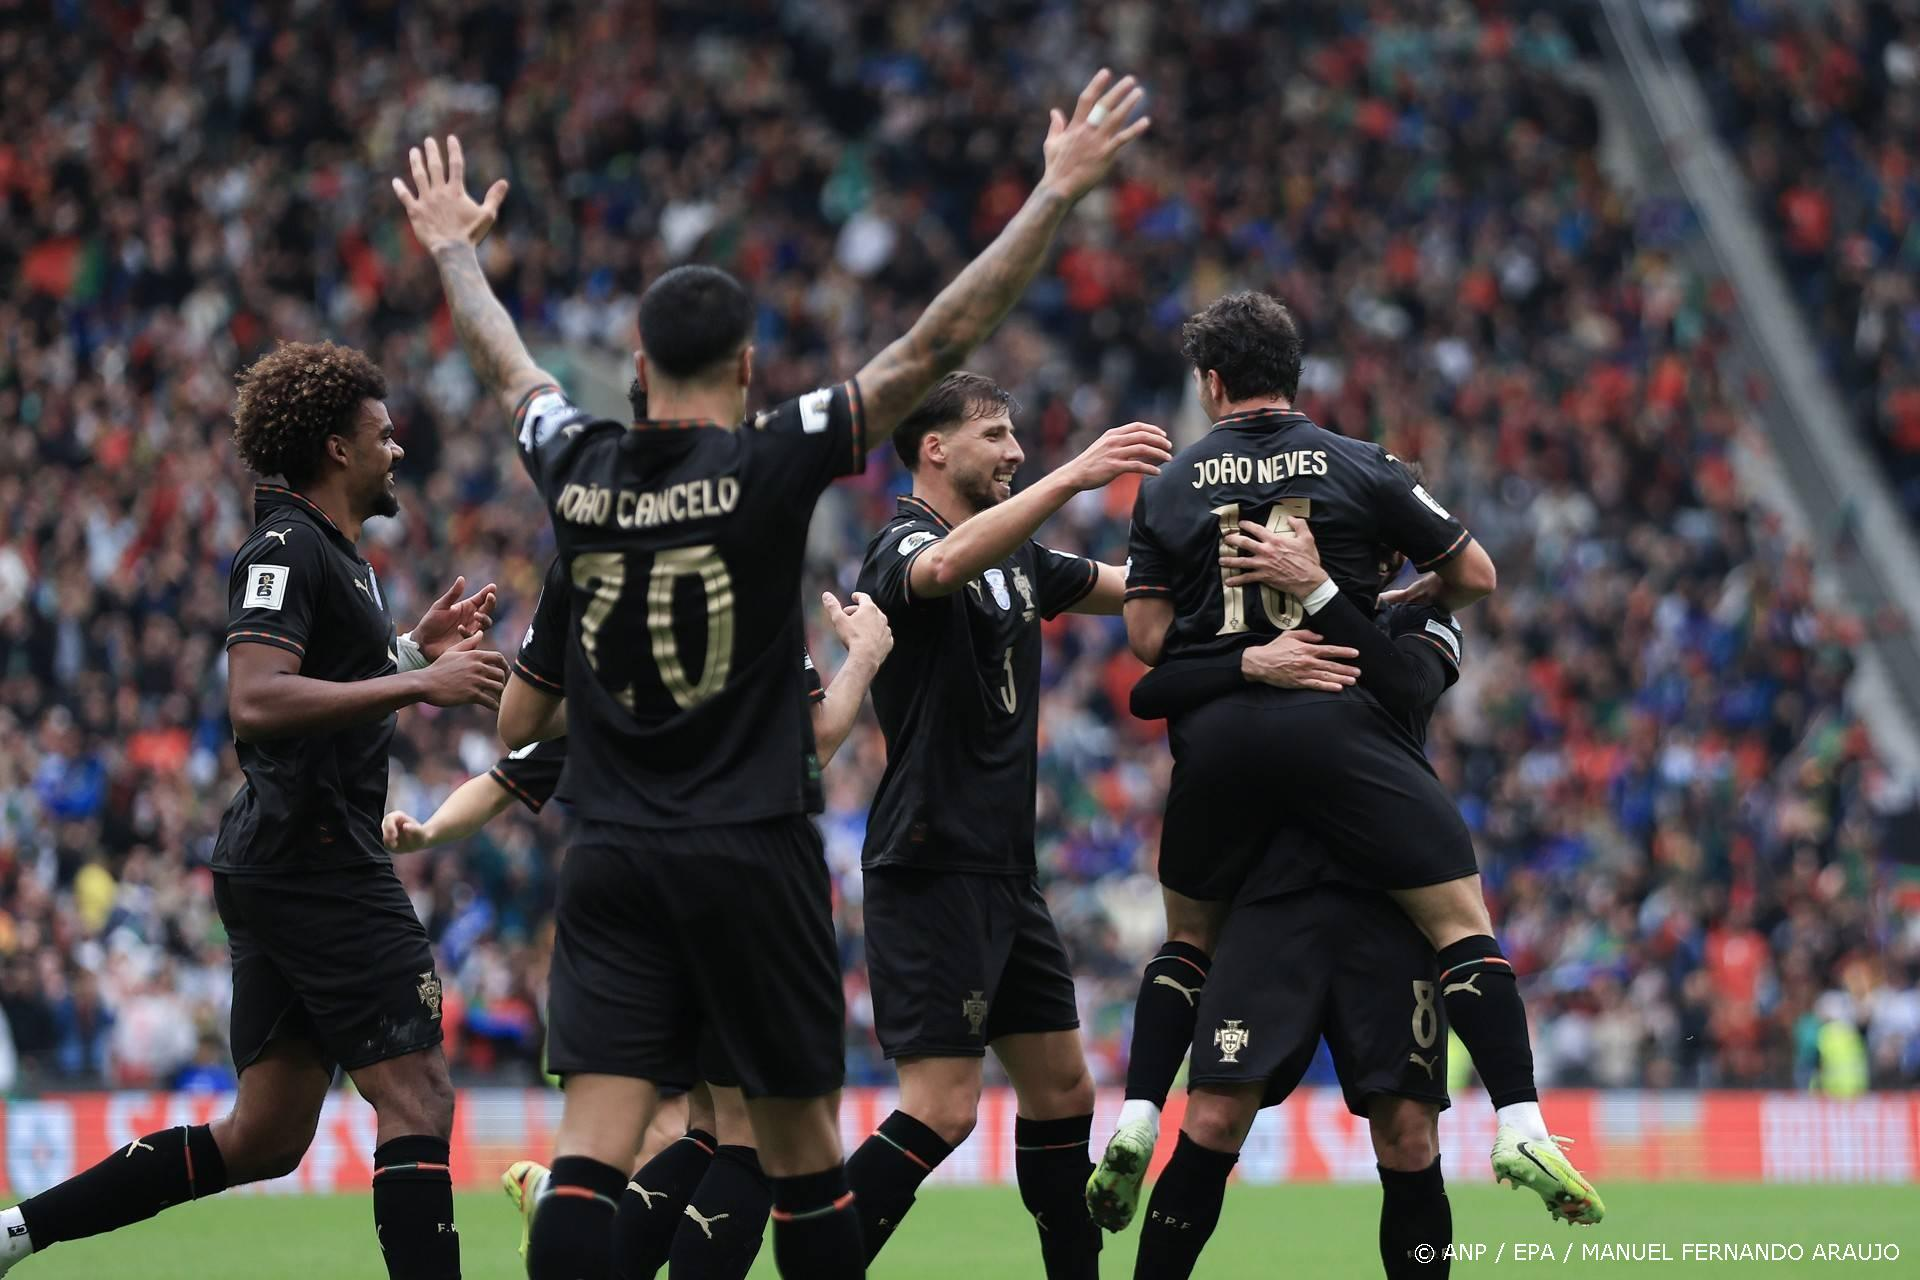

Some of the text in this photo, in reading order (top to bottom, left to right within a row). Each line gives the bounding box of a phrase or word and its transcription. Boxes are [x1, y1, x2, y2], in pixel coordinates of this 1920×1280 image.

[1191, 450, 1328, 489] JOÃO NEVES
[617, 477, 740, 529] CANCELO
[1411, 980, 1437, 1049] 8
